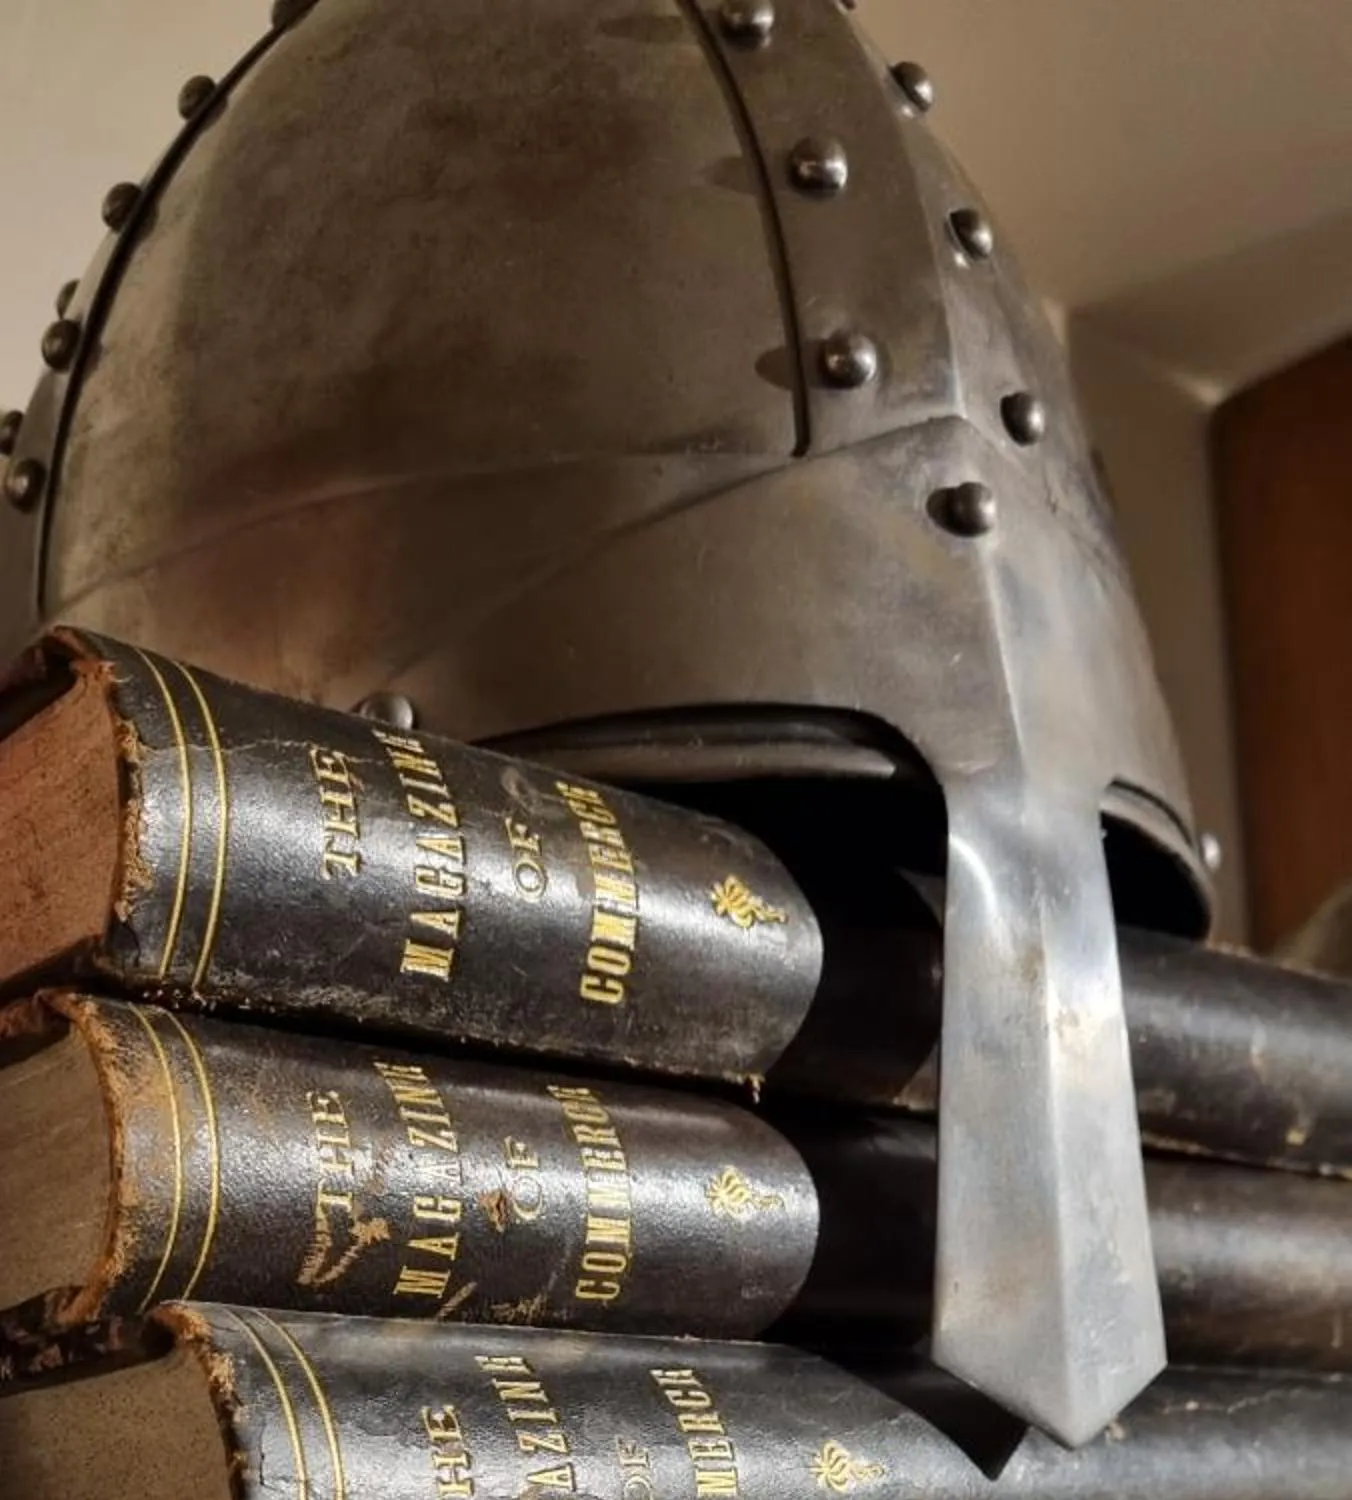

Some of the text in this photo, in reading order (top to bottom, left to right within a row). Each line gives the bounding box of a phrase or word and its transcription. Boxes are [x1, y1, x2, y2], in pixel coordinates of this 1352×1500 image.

[311, 744, 362, 881] THE
[373, 729, 466, 984] MAGAZINE
[505, 820, 547, 903] OF
[556, 778, 640, 1006] COMMERCE
[306, 1088, 355, 1214] THE
[374, 1060, 462, 1300] MAGAZINE
[504, 1134, 543, 1224] OF
[547, 1083, 631, 1303] COMMERCE
